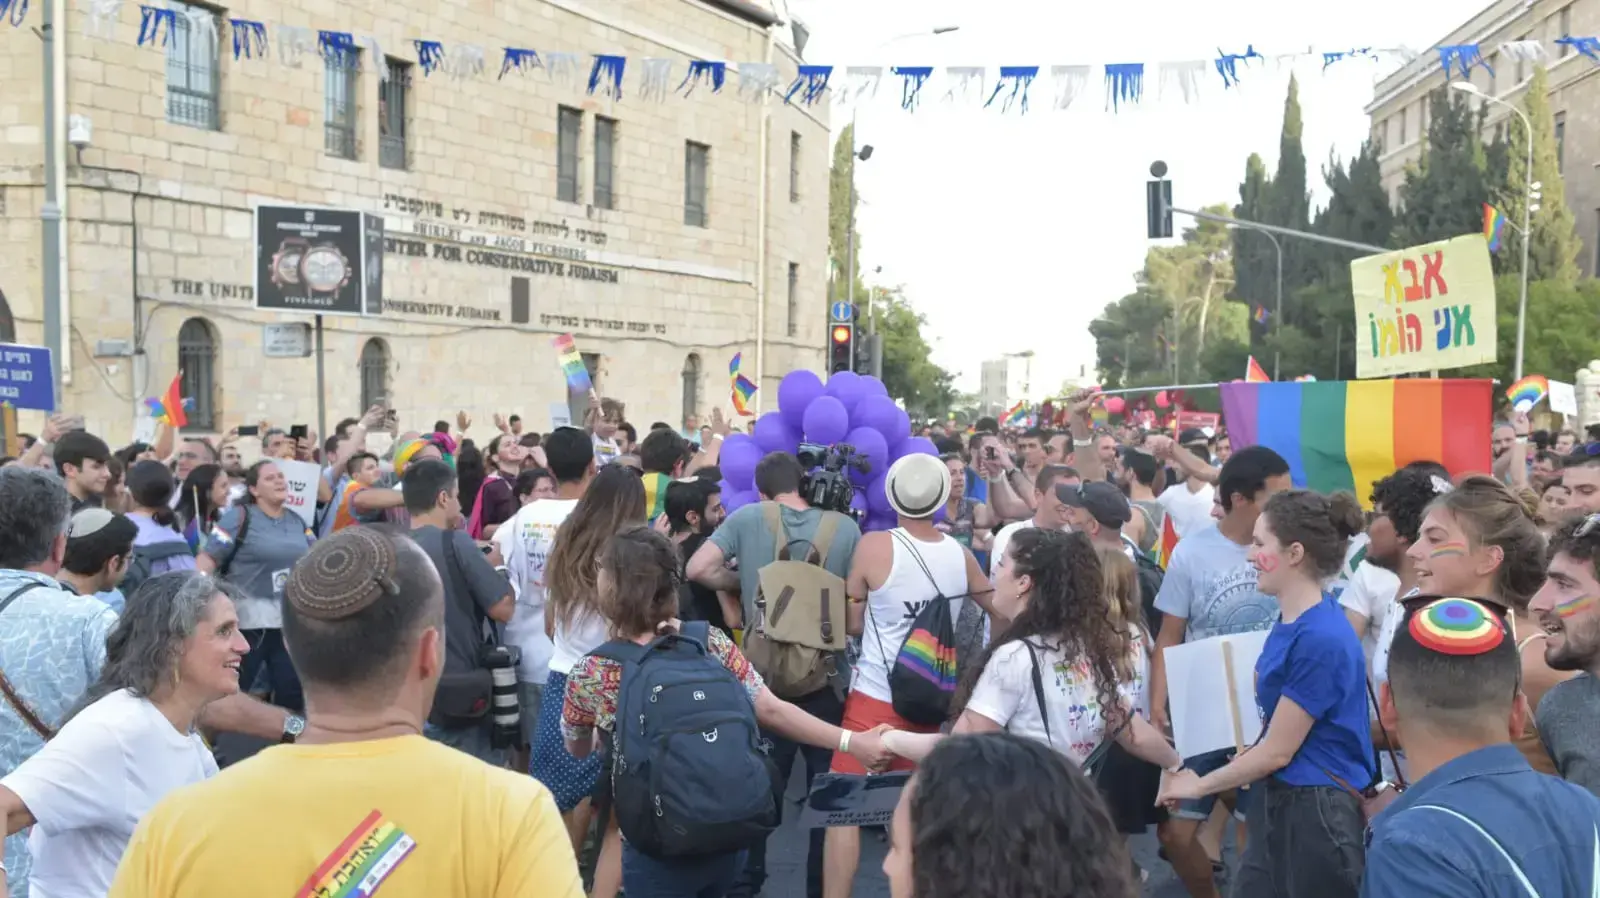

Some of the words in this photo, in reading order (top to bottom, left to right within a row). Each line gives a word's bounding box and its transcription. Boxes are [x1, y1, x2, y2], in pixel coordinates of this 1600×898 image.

[432, 243, 463, 262] FOR
[466, 249, 565, 277] CONSERVATIVE
[567, 263, 619, 284] JUDAISM
[1381, 249, 1448, 305] אבא
[171, 279, 204, 297] THE
[455, 304, 501, 321] JUDAISM
[1433, 303, 1476, 352] אני
